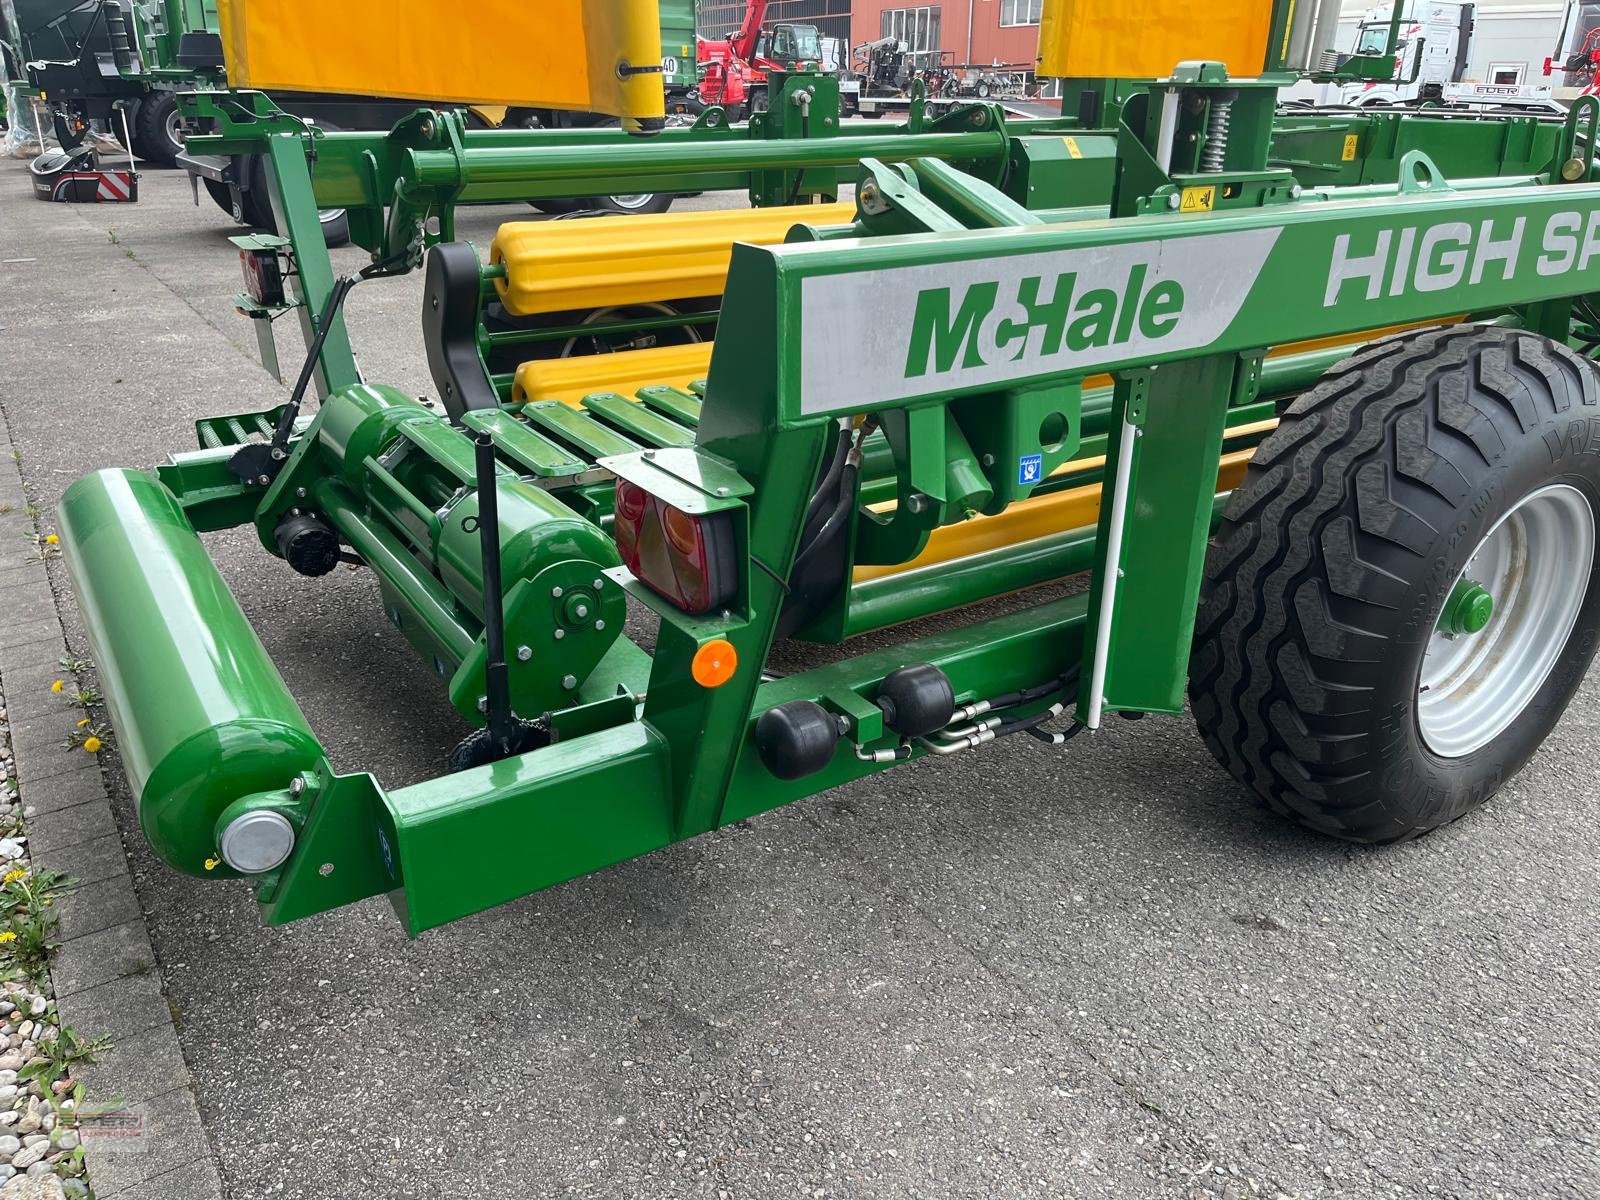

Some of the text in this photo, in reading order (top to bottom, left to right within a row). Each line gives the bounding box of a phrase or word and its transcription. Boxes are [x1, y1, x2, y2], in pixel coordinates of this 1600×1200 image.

[663, 59, 675, 73] 40
[1476, 86, 1519, 95] EDER
[1323, 216, 1527, 308] HIGH
[904, 263, 1185, 379] McHale
